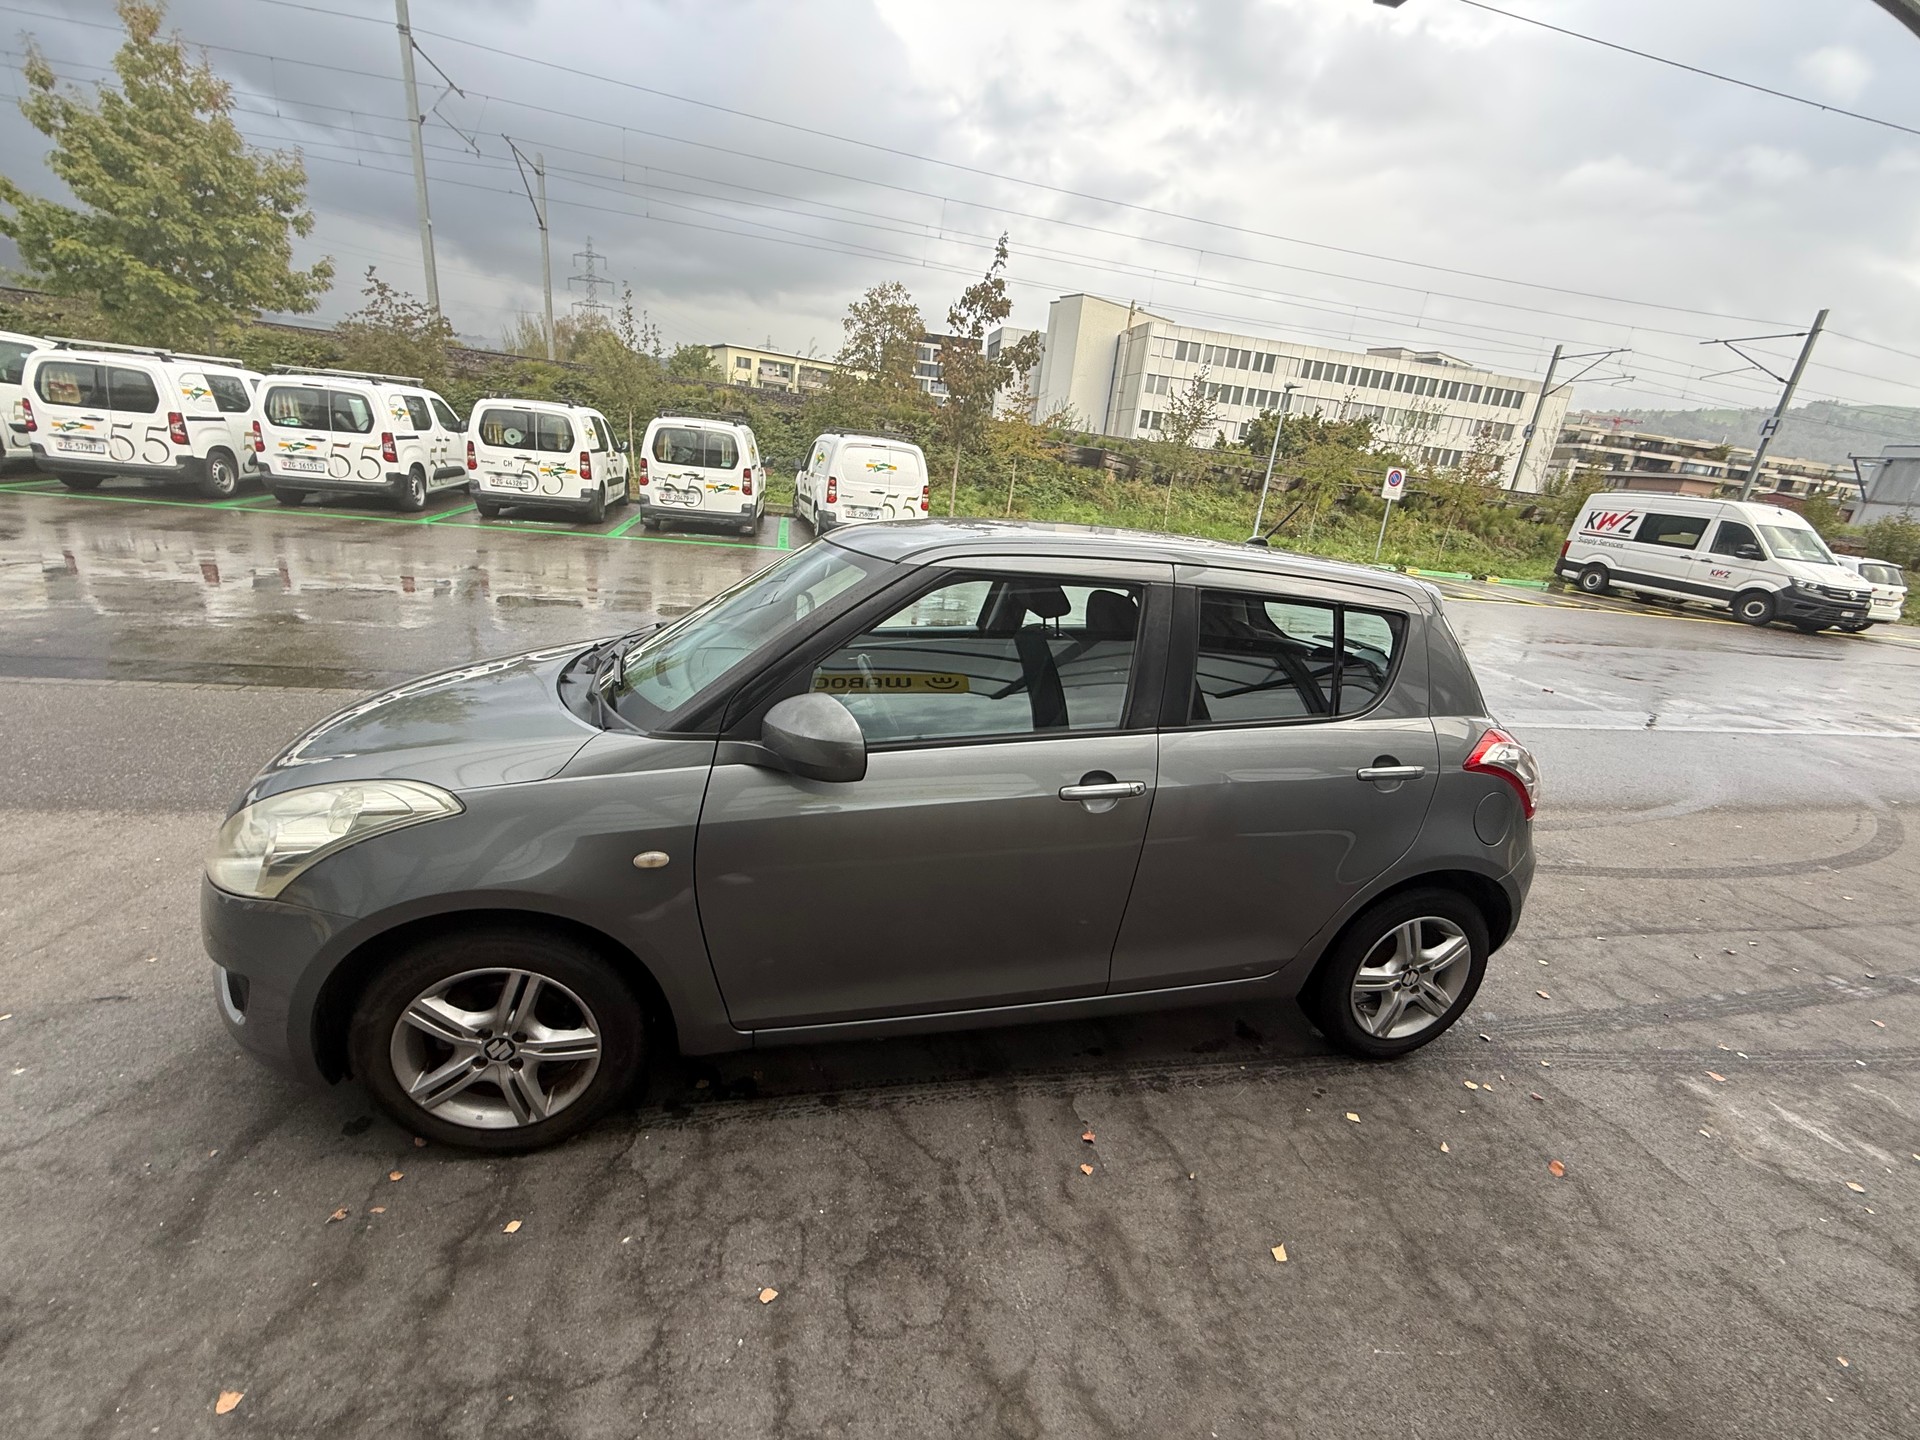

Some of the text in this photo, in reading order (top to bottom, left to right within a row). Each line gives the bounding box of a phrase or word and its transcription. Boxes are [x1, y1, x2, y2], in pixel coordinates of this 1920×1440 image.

[1761, 419, 1780, 436] H
[64, 440, 73, 449] ZG
[108, 422, 170, 464] 55
[288, 461, 296, 469] ZG
[327, 442, 382, 480] 55
[503, 459, 513, 467] CH
[496, 477, 504, 485] ZG
[1584, 509, 1639, 534] KWZ
[1578, 535, 1624, 549] Supply Services
[1709, 568, 1732, 579] KWZ
